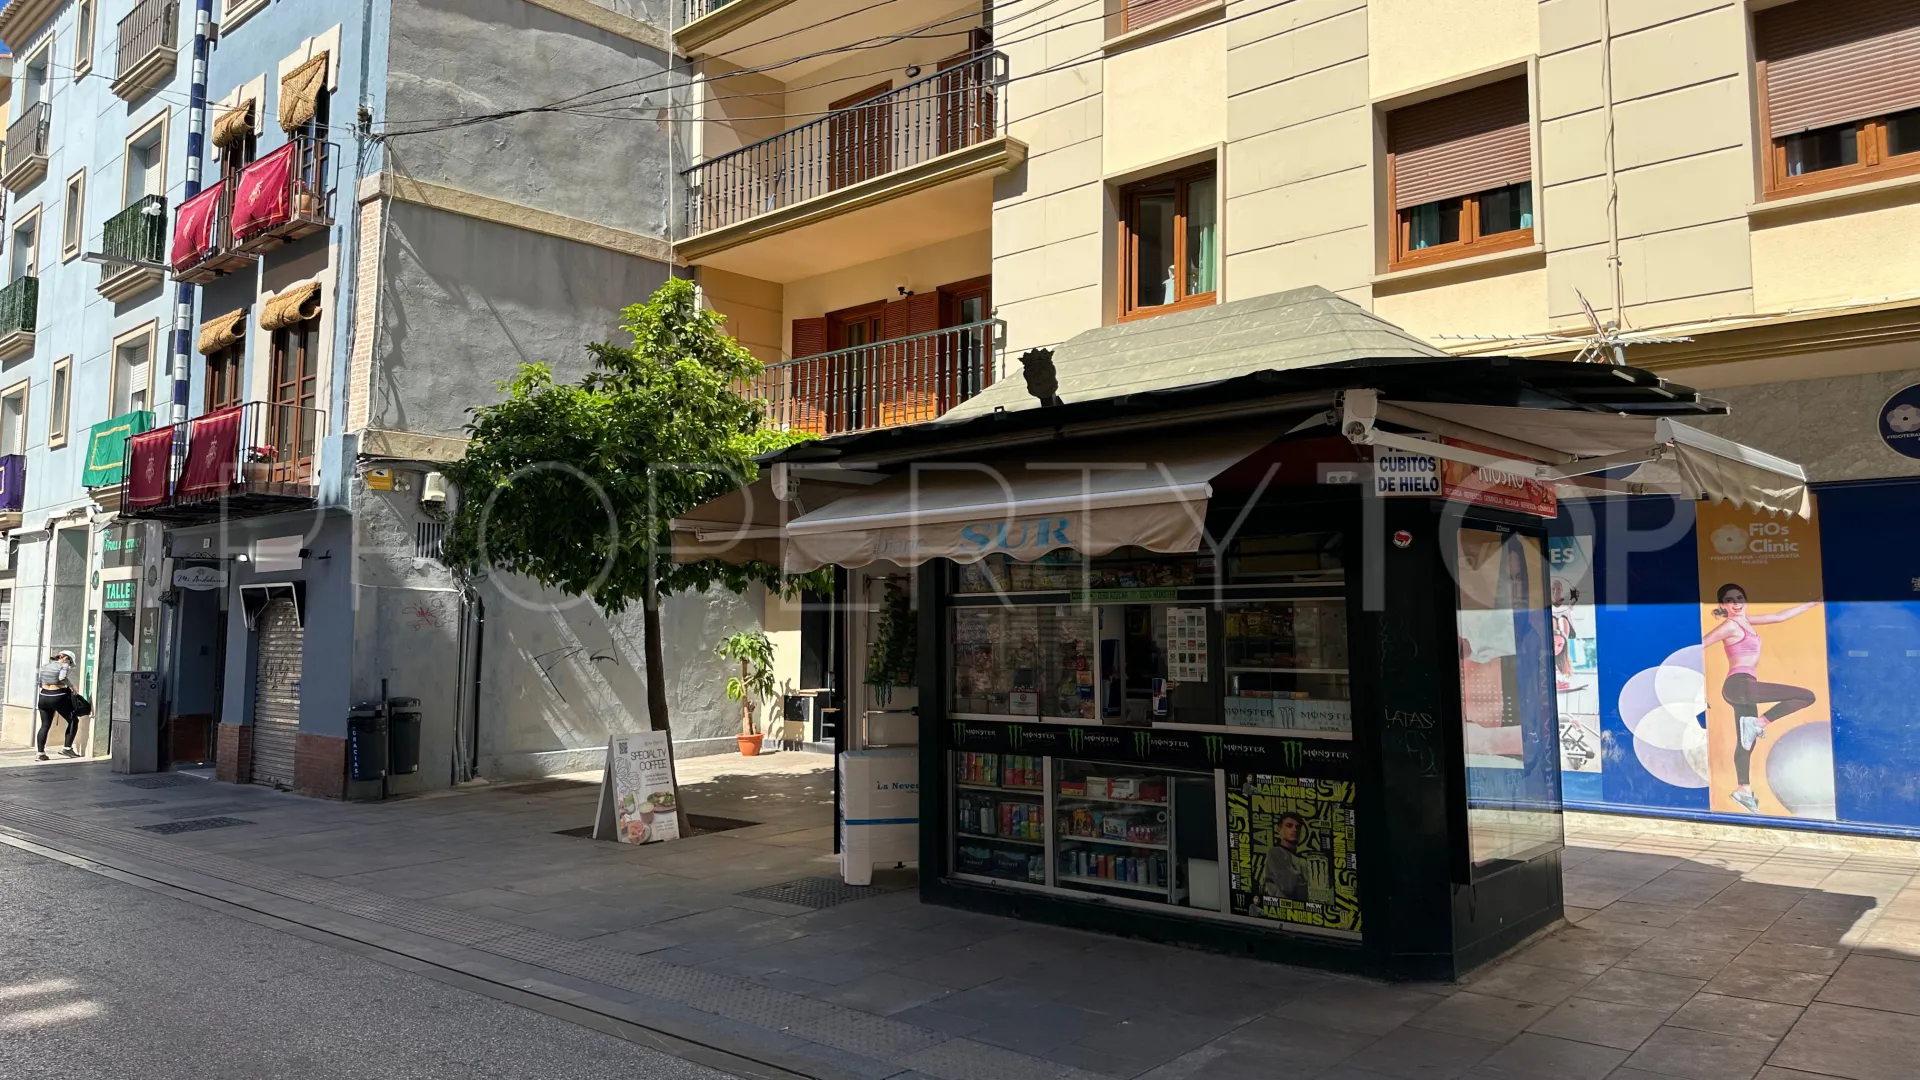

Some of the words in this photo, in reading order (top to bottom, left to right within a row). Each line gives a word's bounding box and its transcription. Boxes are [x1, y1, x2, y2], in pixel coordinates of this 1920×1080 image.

[1379, 456, 1437, 473] CUBITOS
[1378, 476, 1396, 492] DE
[1400, 476, 1440, 492] HIELO
[959, 516, 1071, 552] SUR
[1749, 522, 1789, 536] FiOs
[1749, 538, 1799, 553] Clinic
[1549, 548, 1575, 564] ES
[106, 582, 136, 599] TALLER
[1301, 709, 1352, 722] MONSTE
[965, 728, 996, 738] MONSTER
[1022, 730, 1056, 741] MONSTER
[1083, 733, 1120, 745] MONSTER
[1150, 739, 1190, 749] MONSTER
[1223, 743, 1267, 754] MONSTER
[630, 748, 667, 761] SPECIALTY
[1302, 748, 1350, 761] MONSTER
[639, 758, 668, 772] COFFEE
